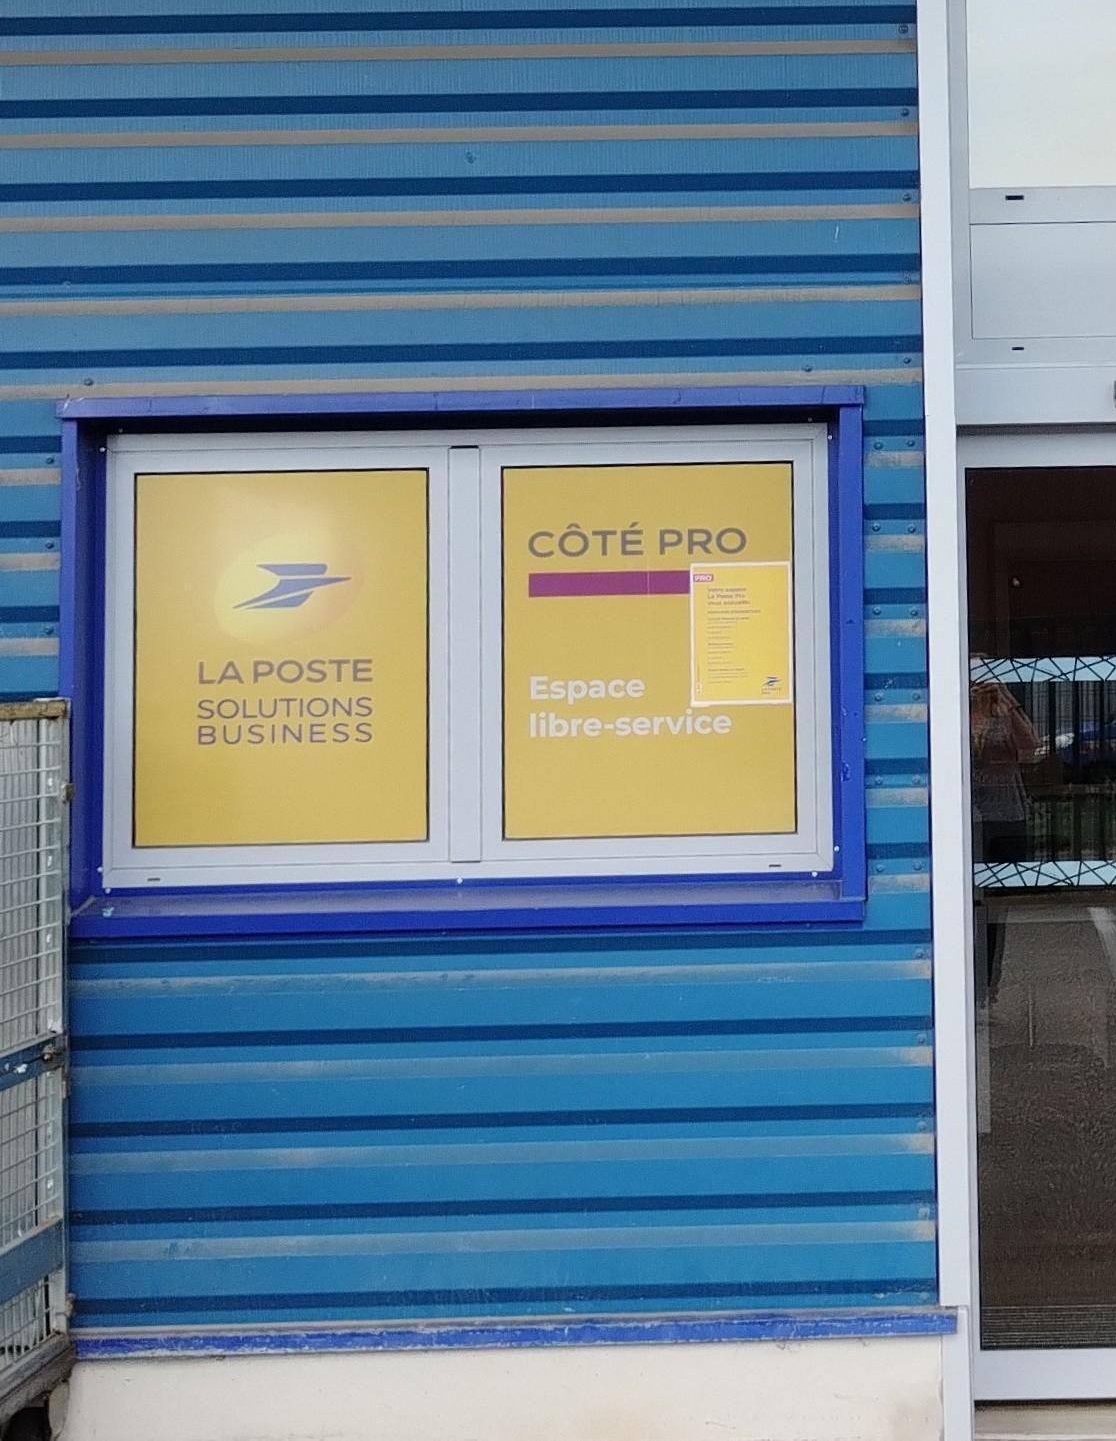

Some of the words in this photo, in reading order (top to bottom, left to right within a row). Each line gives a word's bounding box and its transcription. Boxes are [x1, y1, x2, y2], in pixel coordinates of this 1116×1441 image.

[528, 522, 644, 558] CÔTÉ
[659, 527, 747, 555] PRO
[198, 661, 244, 684] LA
[253, 659, 373, 684] POSTE
[530, 676, 646, 705] Espace
[197, 696, 373, 720] SOLUTIONS
[198, 722, 373, 745] BUSINESS
[530, 709, 733, 738] libre-service
